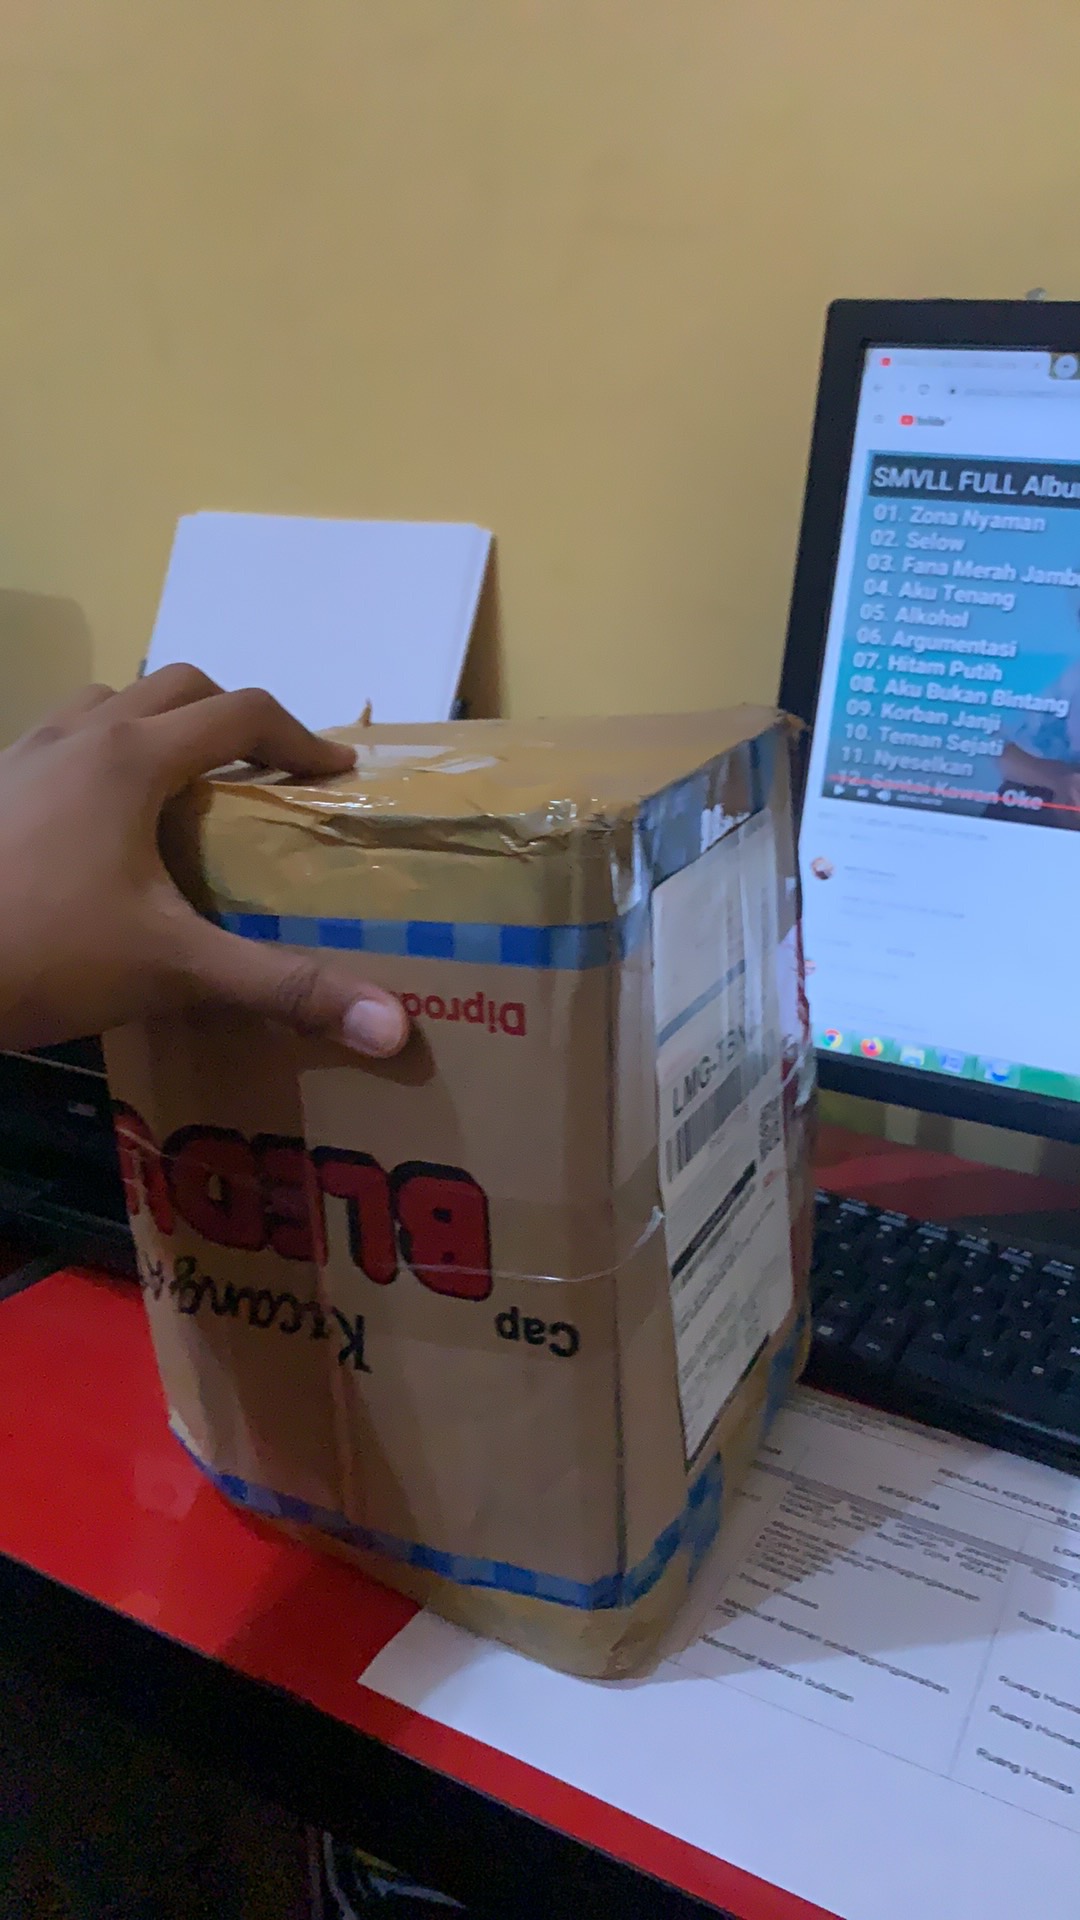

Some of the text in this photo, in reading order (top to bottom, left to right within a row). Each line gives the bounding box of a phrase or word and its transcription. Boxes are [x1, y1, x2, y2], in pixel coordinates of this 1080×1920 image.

[872, 466, 953, 492] SMVLL
[958, 471, 1017, 495] FULL
[874, 504, 1046, 533] 01. Zona Nyaman
[870, 530, 966, 552] 02. Selow
[867, 554, 1080, 588] 03. Fana Merah Jamb
[864, 579, 1016, 612] 04. Aku Tenang
[859, 603, 970, 629] 05. Alkohol
[856, 628, 1018, 658] 06. Argumentasi
[853, 652, 1003, 682] 07. Hitam Putih
[849, 675, 1071, 718] 08. Aku Bukan Bintang
[846, 700, 1002, 735] 09. Korban Janji
[845, 724, 1005, 758] 10. Teman Sejati
[841, 748, 975, 778] 11. Nyeselkan
[1002, 789, 1044, 812] Oke
[493, 1305, 580, 1358] Cap
